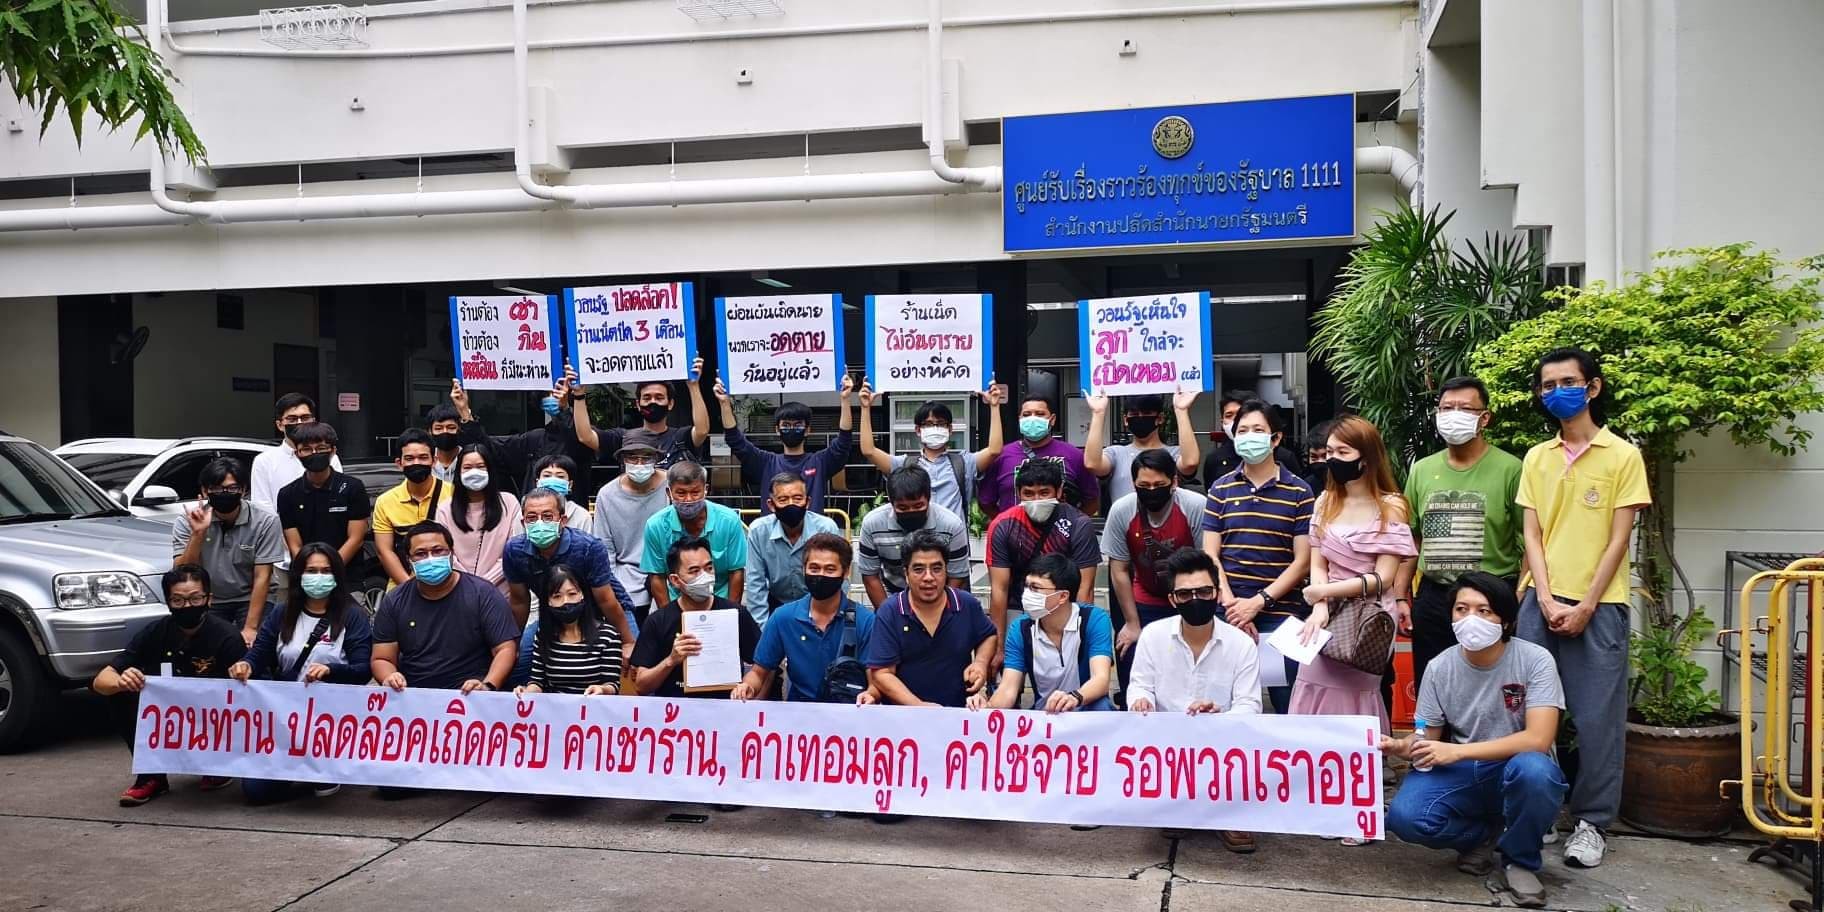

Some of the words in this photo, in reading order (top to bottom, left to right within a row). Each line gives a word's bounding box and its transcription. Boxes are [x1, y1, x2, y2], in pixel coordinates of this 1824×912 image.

[1014, 158, 1295, 213] ศูนย์รับเรื่องราวร้องทุกข์ของรัฐบาล
[1301, 160, 1341, 188] 1111
[1045, 204, 1308, 237] สำนักงานปลัดสำนักนายกรัฐมนตรี
[460, 300, 499, 322] ร้านต้อง
[508, 296, 539, 321] เช่า
[574, 294, 610, 316] วอนรัฐ
[726, 300, 824, 321] ผ่อนผันเถิดนาย
[1095, 296, 1187, 327] วอนรัฐเห็นใจ
[462, 329, 500, 351] ข้าวต้อง
[517, 323, 547, 352] กิน
[634, 319, 650, 342] 3
[654, 318, 686, 340] เดือน
[880, 325, 973, 351] ไม่อันตราย
[462, 351, 499, 380] หนี้สิน
[501, 357, 550, 380] ก็มีนะท่าน
[585, 346, 673, 374] จะอดตายแล้ว
[742, 358, 821, 389] กันอยู่แล้ว
[890, 351, 971, 379] อย่างที่คิด
[1093, 360, 1177, 386] เปิดเทอม
[1180, 366, 1200, 381] แล้ว
[140, 690, 275, 756] วอนท่าน
[287, 692, 551, 770] ปลดล๊อคเถิดครับ
[564, 702, 727, 786] ค่าเช่าร้าน,
[740, 712, 929, 812] ค่าเทอมลูก,
[944, 708, 1100, 796] ค่าใช้จ่าย
[1114, 730, 1378, 840] รอพวกเราอยู่
